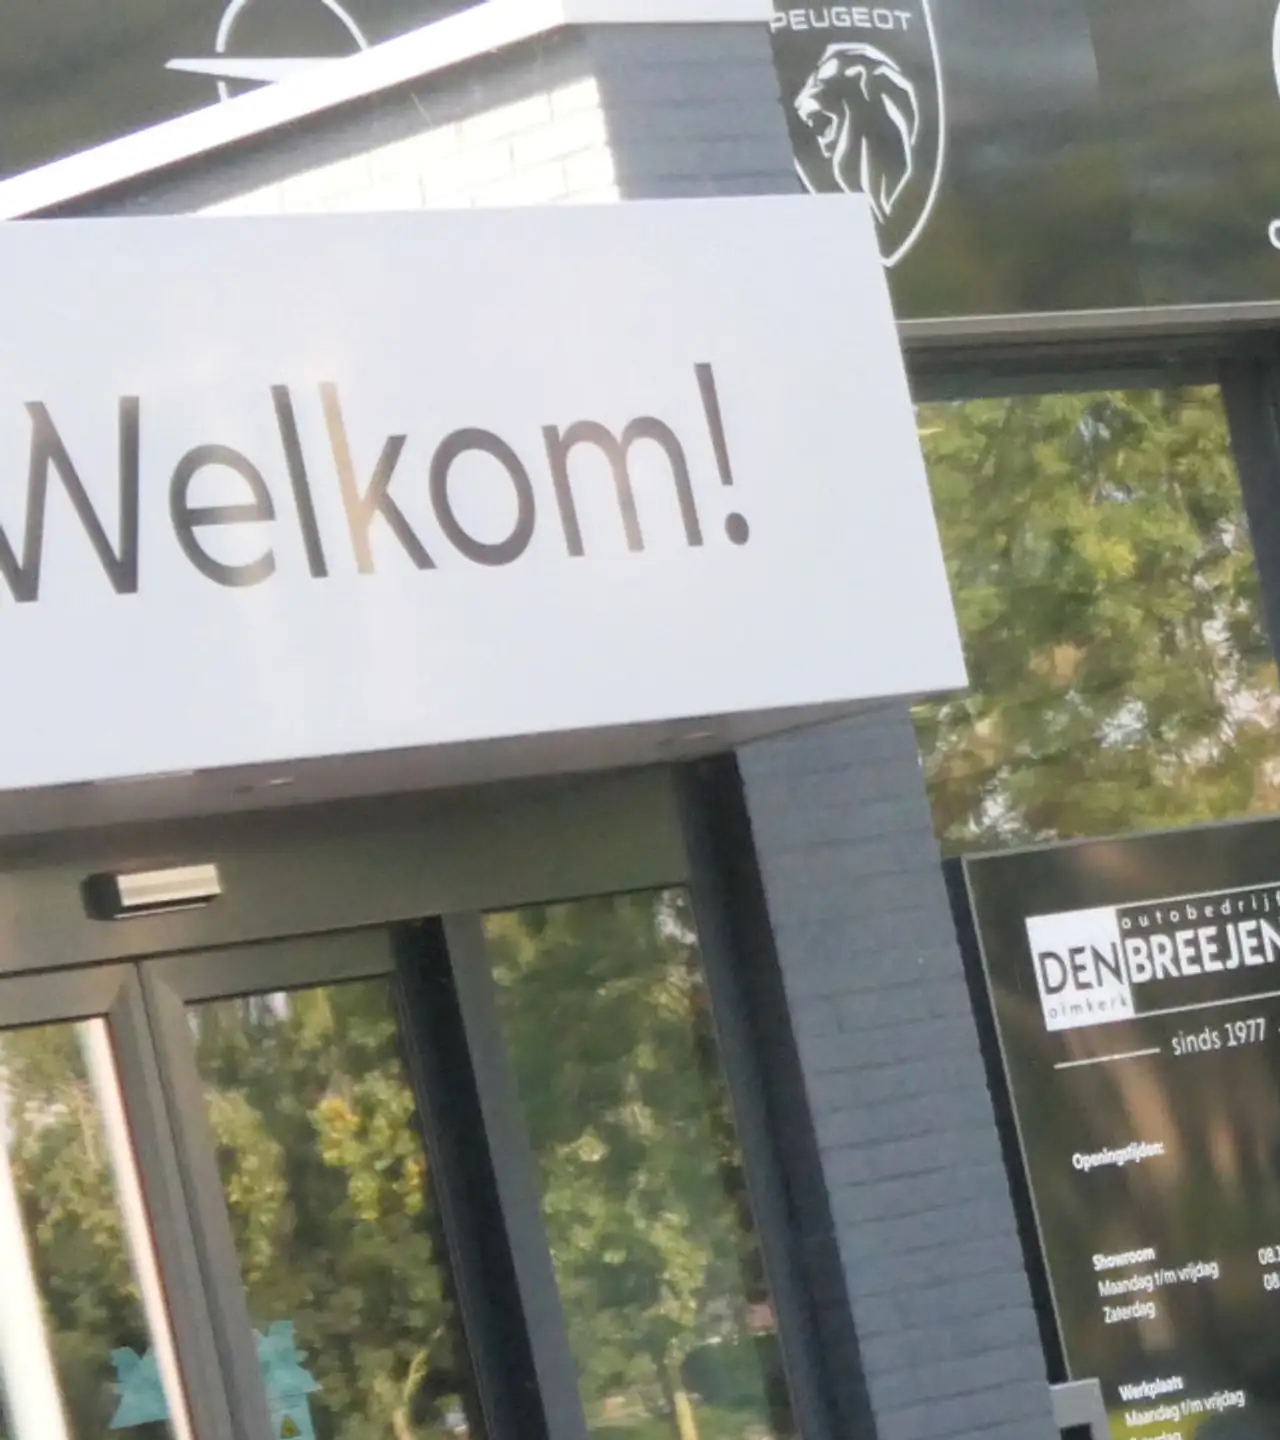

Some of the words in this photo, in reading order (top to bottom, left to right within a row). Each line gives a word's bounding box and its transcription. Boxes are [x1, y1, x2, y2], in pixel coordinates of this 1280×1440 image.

[769, 5, 912, 33] PEUGEOT
[0, 362, 751, 603] Welkom!
[1038, 941, 1124, 996] DEN
[1171, 1025, 1222, 1056] sinds
[1223, 1016, 1267, 1048] 1977
[1098, 1273, 1154, 1297] Maandag
[1102, 1299, 1157, 1325] Zaterdag
